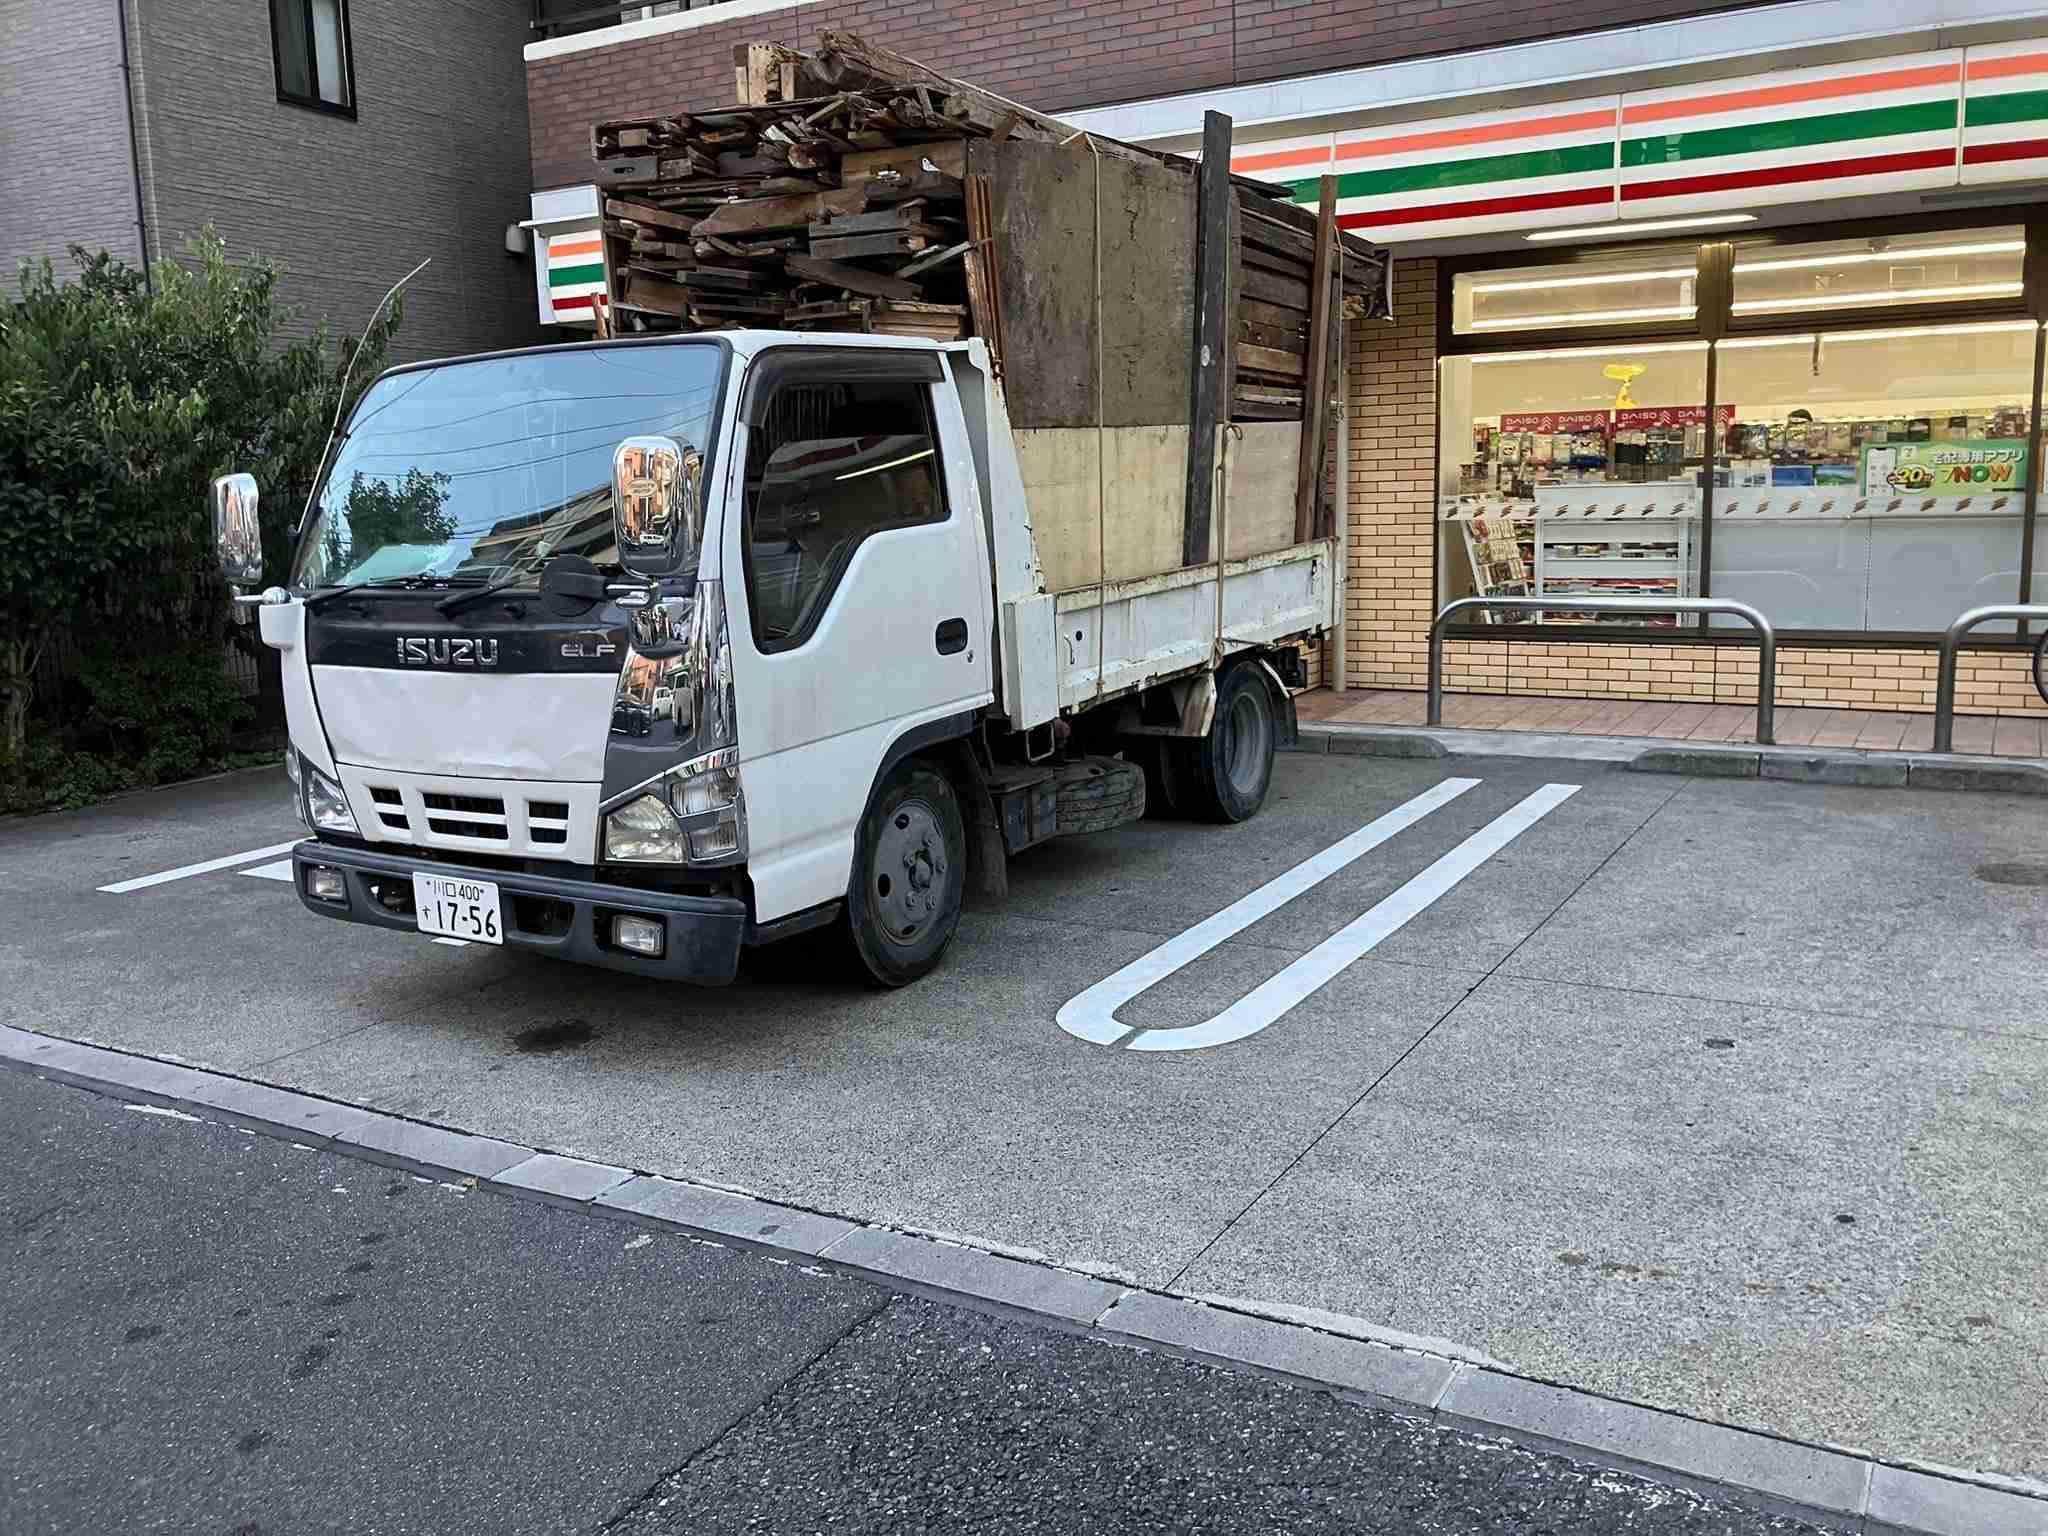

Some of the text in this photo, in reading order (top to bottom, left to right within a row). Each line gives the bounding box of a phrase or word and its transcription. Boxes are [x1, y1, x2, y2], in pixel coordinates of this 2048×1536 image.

[1558, 414, 1592, 423] DAISO
[1621, 411, 1657, 420] DAISO
[1678, 409, 1707, 418] DAIS
[1505, 416, 1539, 425] DAISO
[397, 637, 498, 665] ISUZU
[560, 643, 616, 657] ELF
[460, 884, 480, 901] 400
[437, 900, 497, 938] 17-56
